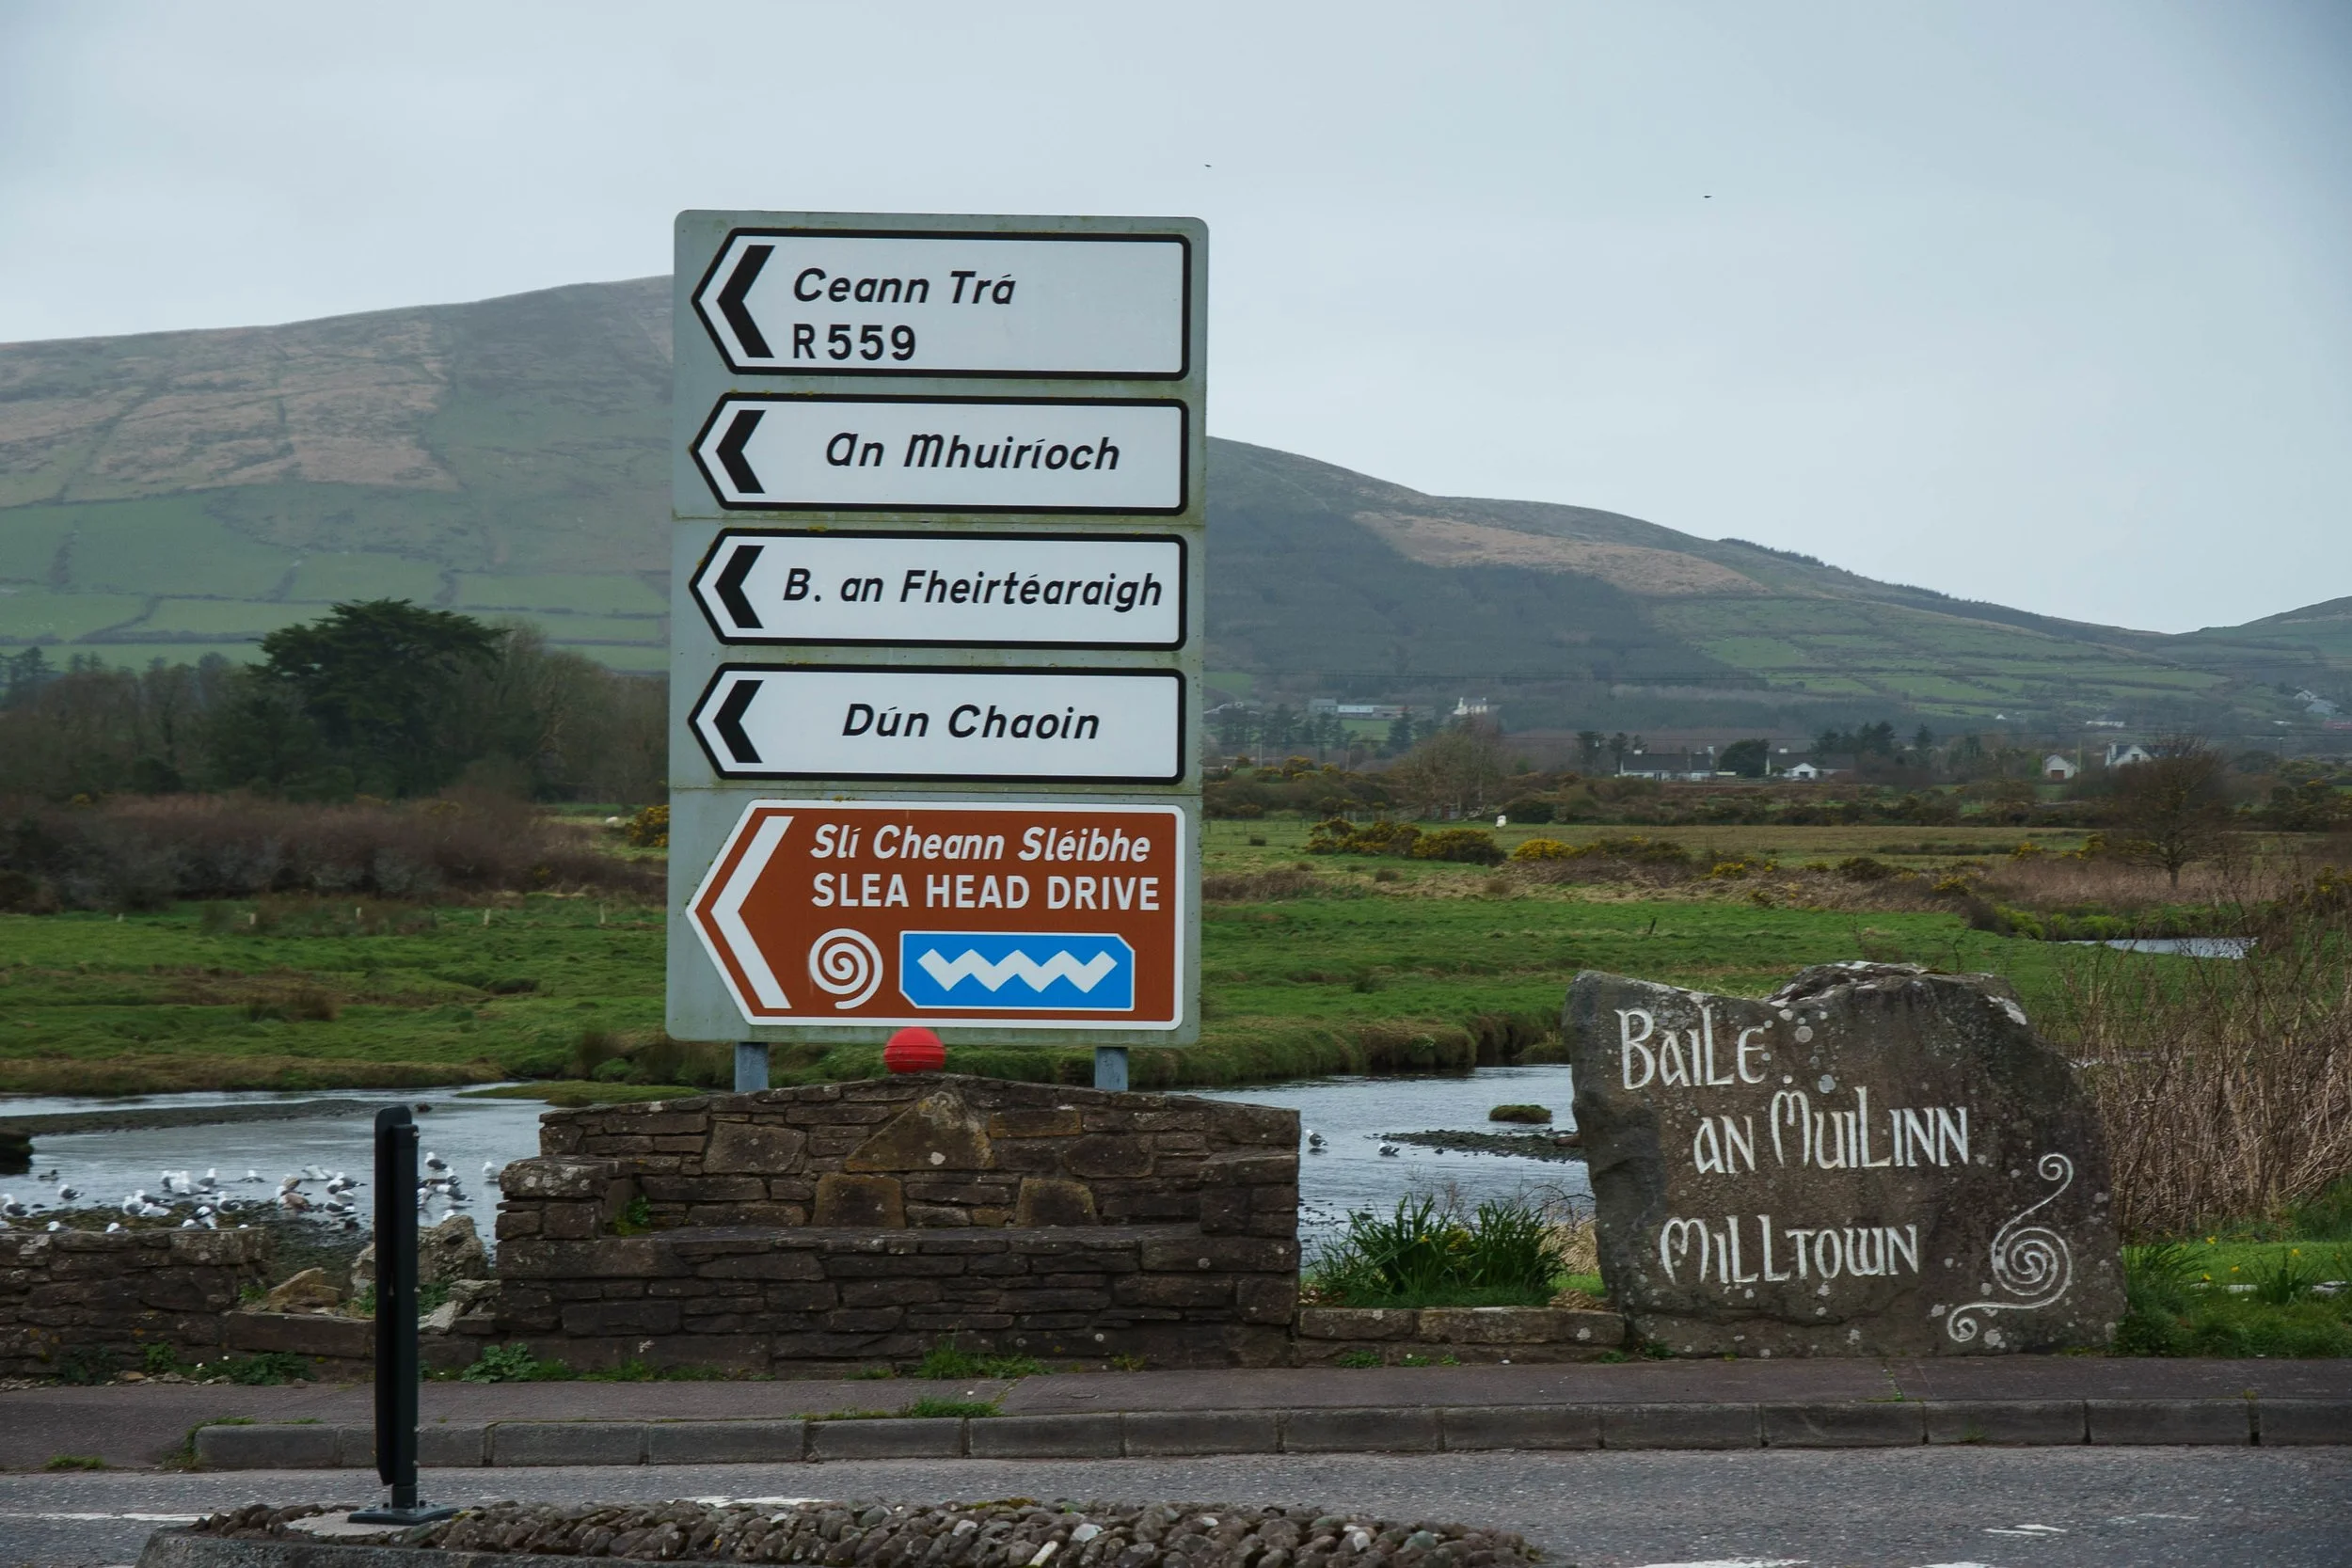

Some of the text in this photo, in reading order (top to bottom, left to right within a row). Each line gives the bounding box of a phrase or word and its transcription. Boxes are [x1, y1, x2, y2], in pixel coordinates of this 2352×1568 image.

[793, 267, 1017, 305] Ceann Trá
[793, 323, 916, 361] R559
[903, 434, 1120, 470] Mhuiríoch
[783, 567, 1162, 613] B. an Fheirtéaraigh
[842, 703, 1100, 739] Dún Chaoin
[809, 823, 1151, 863] Slí Cheann Sléibhe
[811, 872, 1160, 911] SLEA HEAD DRIVE
